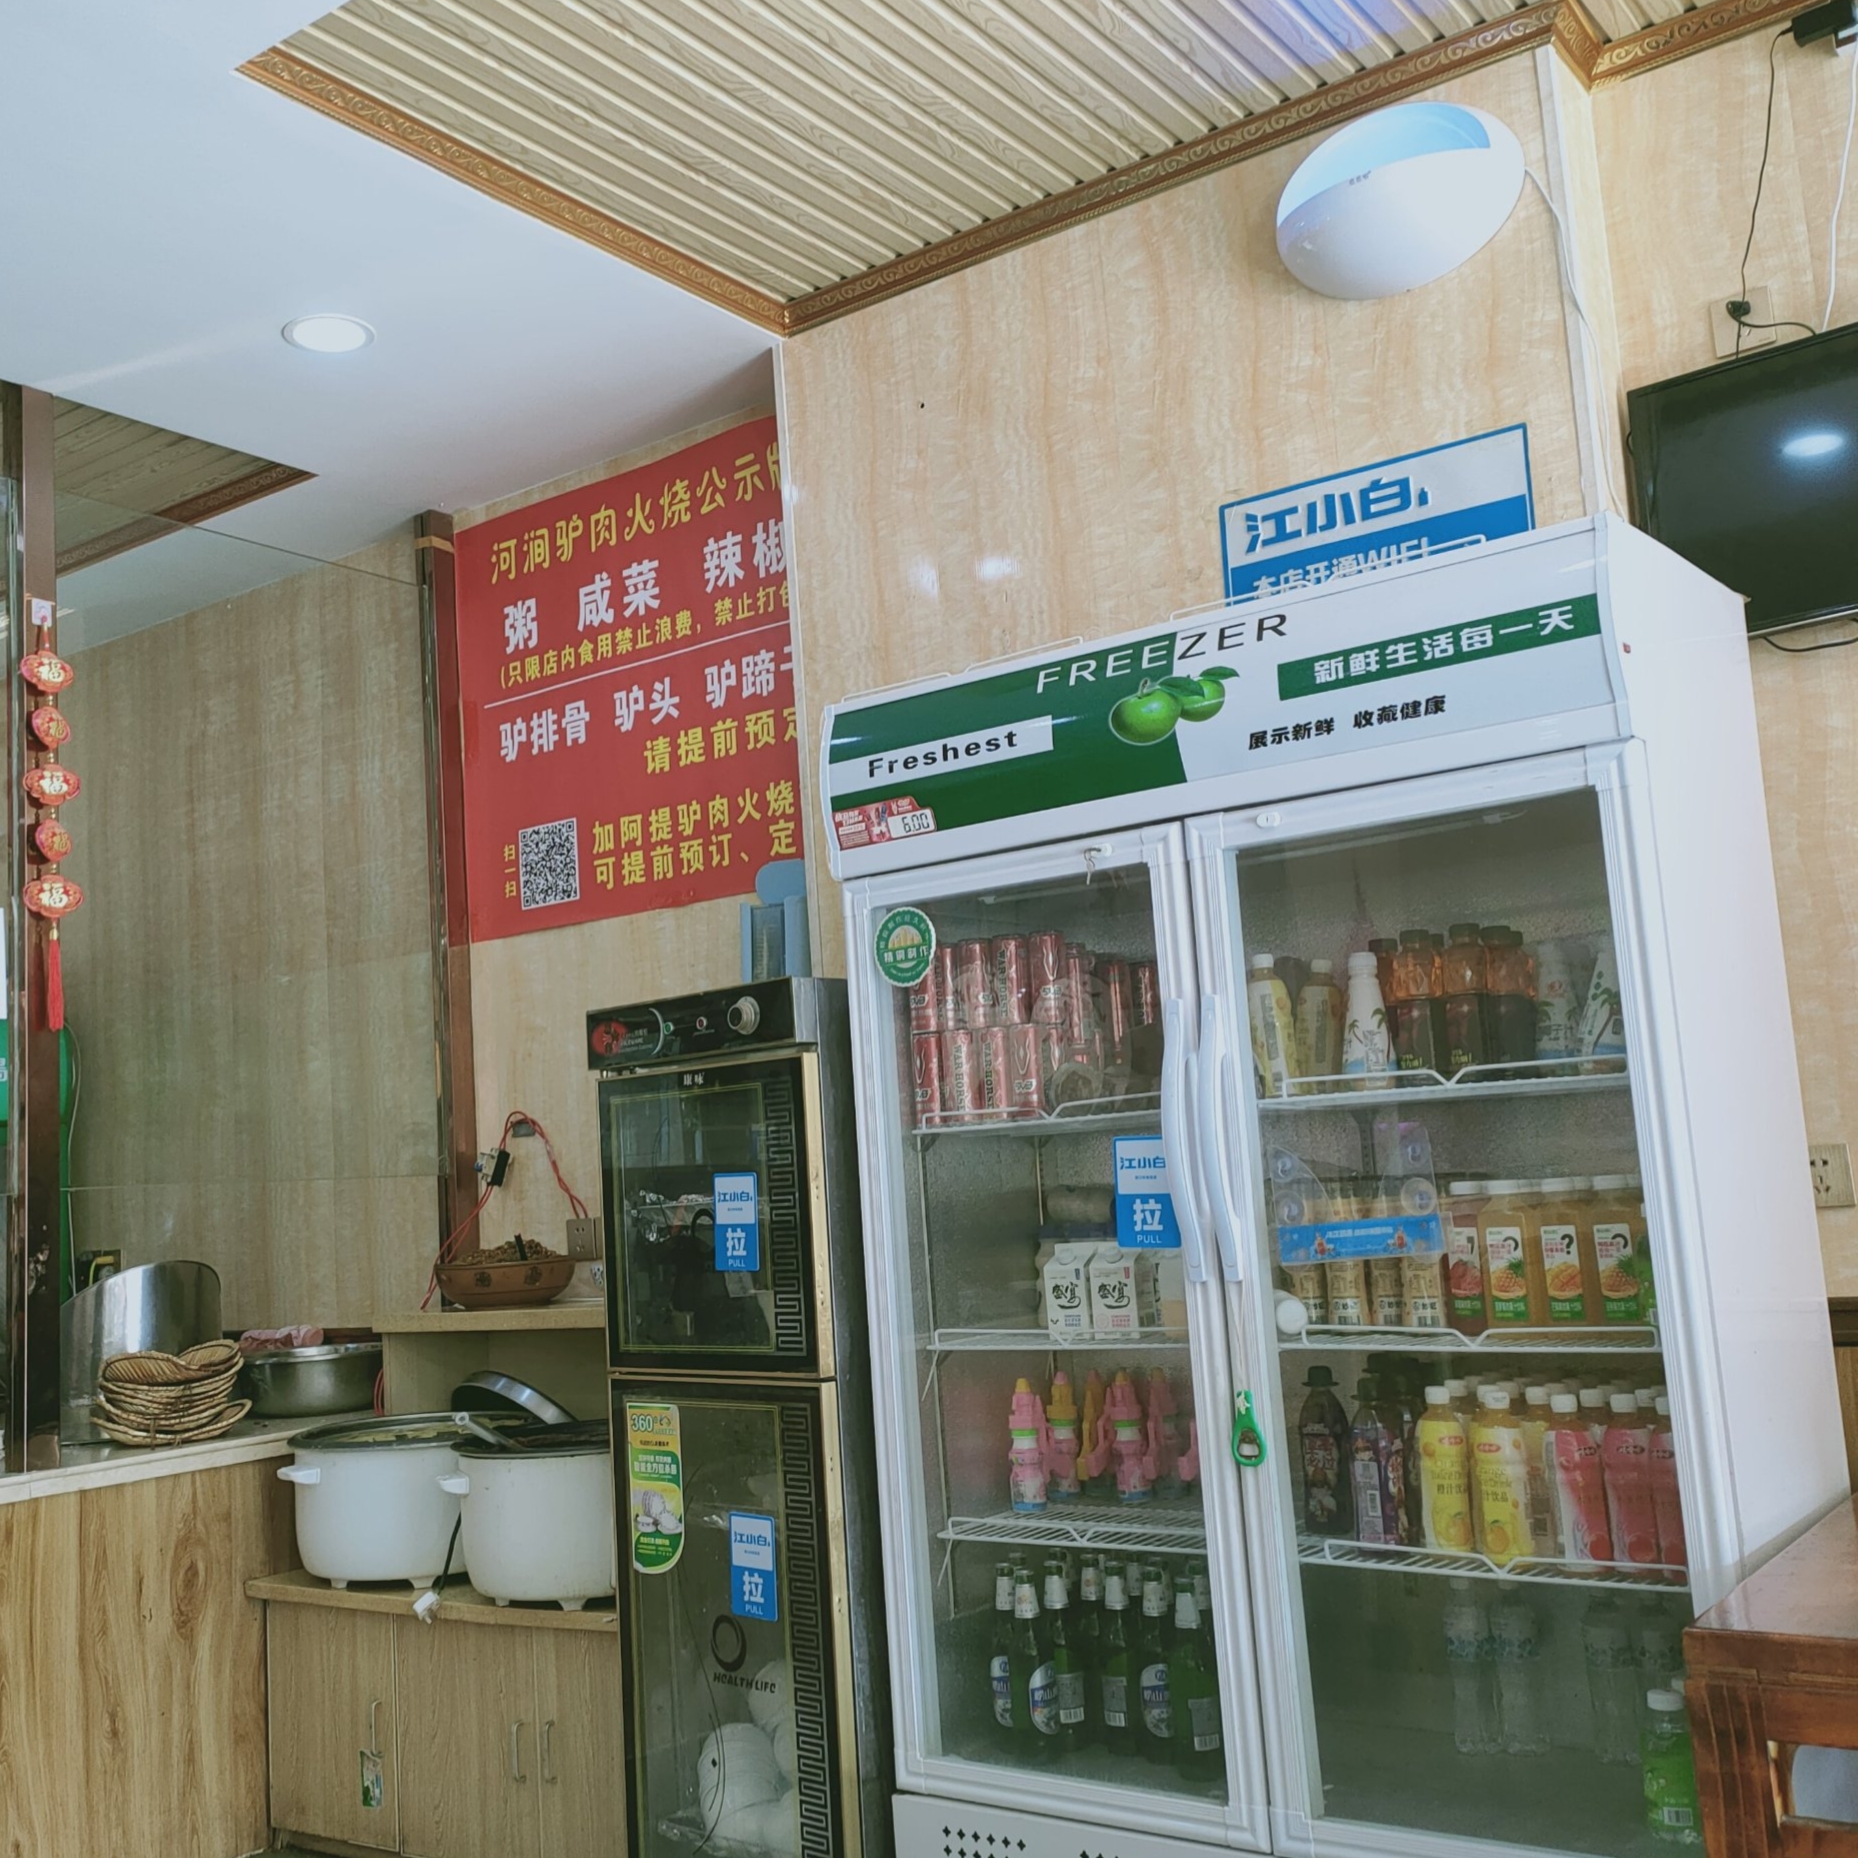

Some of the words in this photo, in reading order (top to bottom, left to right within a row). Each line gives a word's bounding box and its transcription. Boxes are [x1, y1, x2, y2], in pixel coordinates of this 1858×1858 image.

[1245, 477, 1413, 555] 江小白
[504, 598, 538, 655] 粥
[577, 558, 660, 633] 咸菜
[1036, 613, 1288, 695] FREEZER
[1313, 605, 1575, 684] 新鲜生活每一天
[499, 700, 591, 763] 驴排骨
[613, 676, 680, 733] 驴头
[1248, 717, 1336, 751] 展示新鲜
[1352, 695, 1447, 729] 收藏健康
[867, 730, 1018, 779] Freshest
[592, 779, 795, 855] 加阿提驴肉火烧
[902, 812, 931, 834] 6.00
[503, 843, 518, 898] 扫一扫
[1120, 1156, 1166, 1170] 江小白
[717, 1191, 750, 1203] 江小白
[1133, 1198, 1164, 1231] 拉
[726, 1227, 747, 1257] 拉
[1136, 1234, 1163, 1244] PULL
[728, 1259, 746, 1268] PULL
[734, 1530, 767, 1547] 江小白
[743, 1570, 765, 1604] 拉
[745, 1604, 764, 1616] PULL
